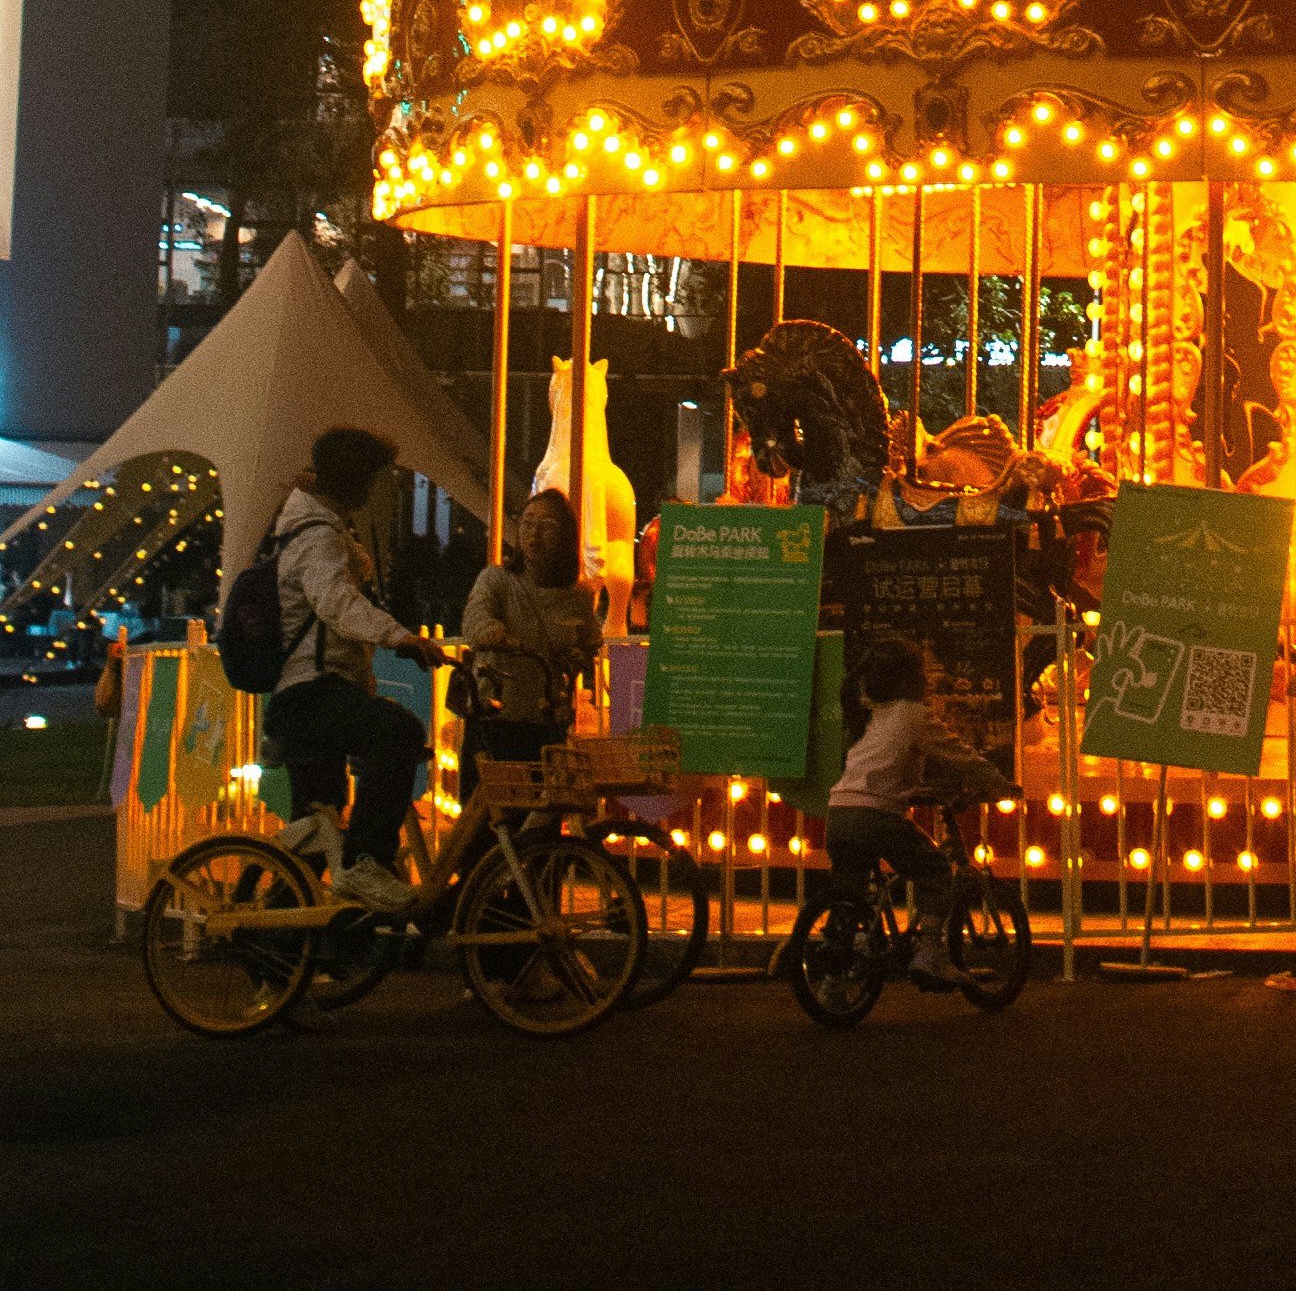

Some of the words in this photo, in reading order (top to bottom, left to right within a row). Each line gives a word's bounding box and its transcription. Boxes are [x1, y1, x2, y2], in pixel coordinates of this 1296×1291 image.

[673, 525, 716, 542] DoBe
[720, 525, 762, 542] PARK
[873, 575, 983, 600] 试运营启幕
[1121, 590, 1158, 607] DoBe
[1160, 594, 1197, 612] PARK
